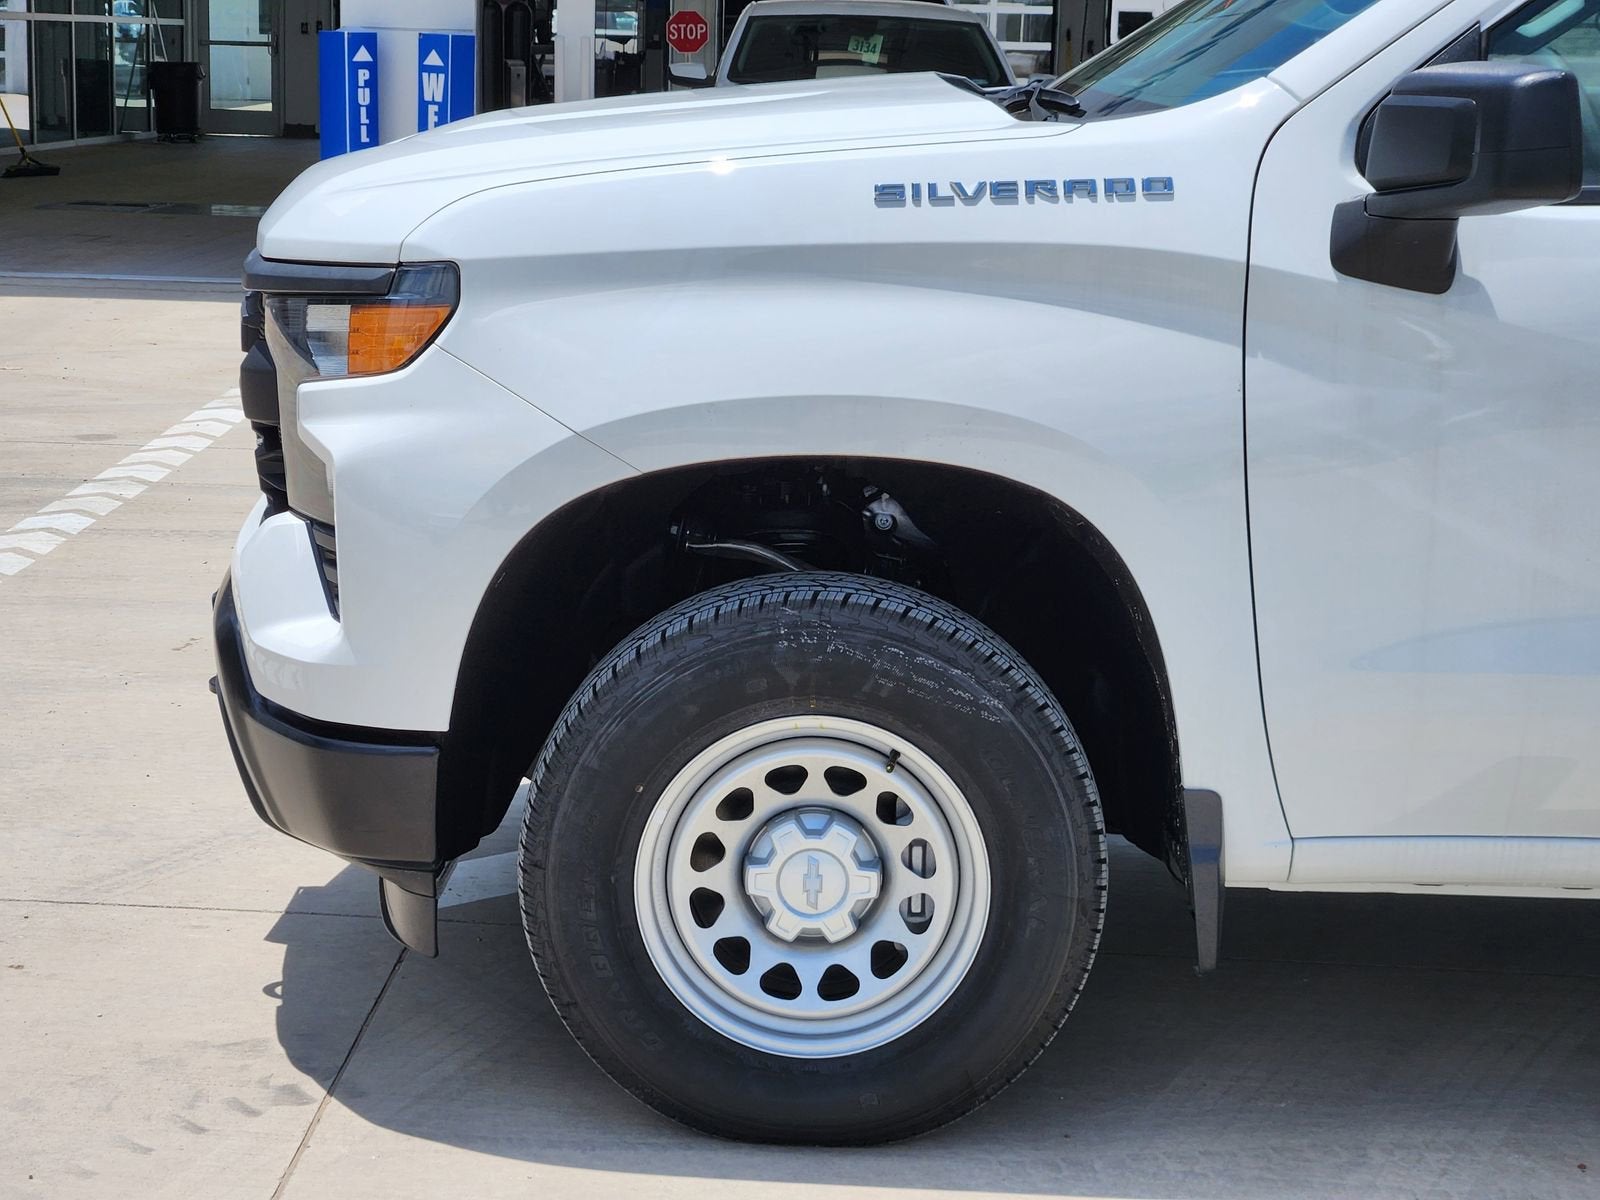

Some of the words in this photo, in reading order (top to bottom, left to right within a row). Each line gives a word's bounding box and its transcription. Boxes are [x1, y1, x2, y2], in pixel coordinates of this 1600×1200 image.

[669, 23, 707, 40] STOP
[357, 68, 371, 143] PULL
[873, 176, 1176, 208] SILVERADO
